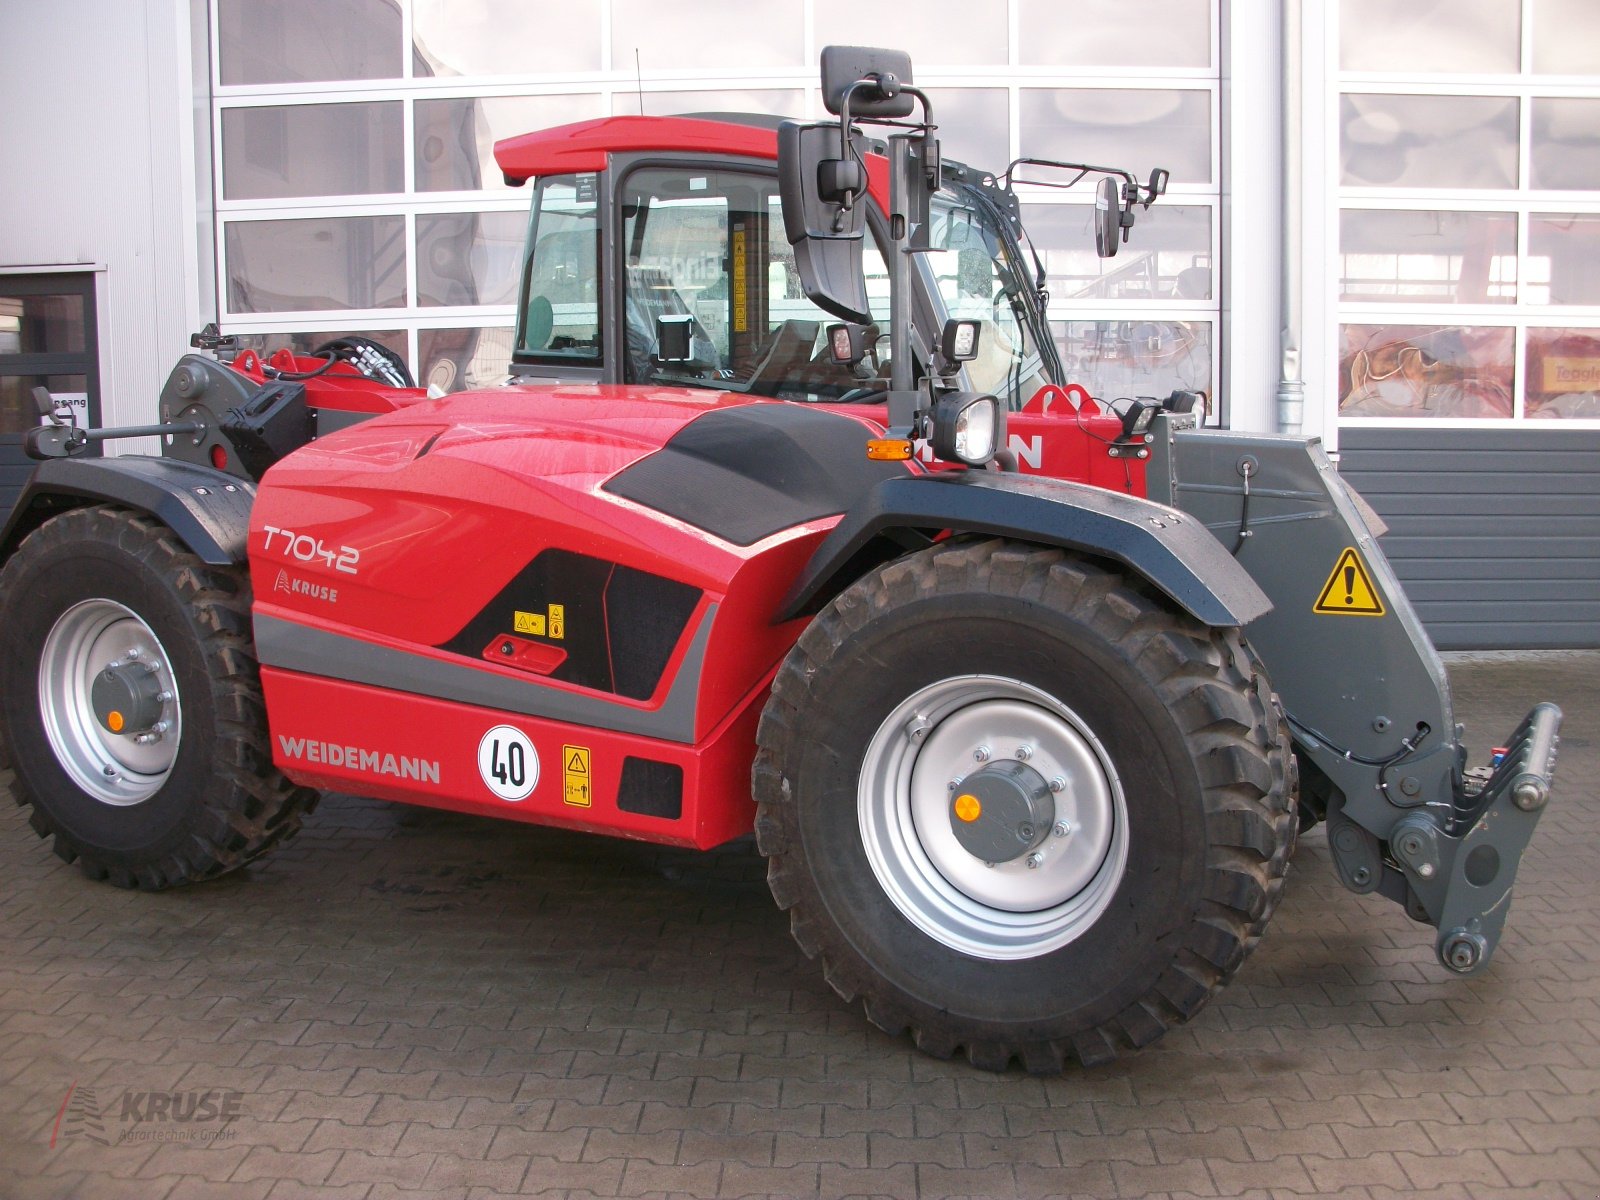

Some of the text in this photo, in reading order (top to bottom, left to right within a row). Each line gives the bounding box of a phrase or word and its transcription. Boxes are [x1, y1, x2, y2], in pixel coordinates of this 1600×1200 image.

[264, 525, 360, 574] T7042
[291, 578, 338, 603] KRUSE
[278, 734, 440, 784] WEIDEMANN
[491, 739, 526, 786] 40
